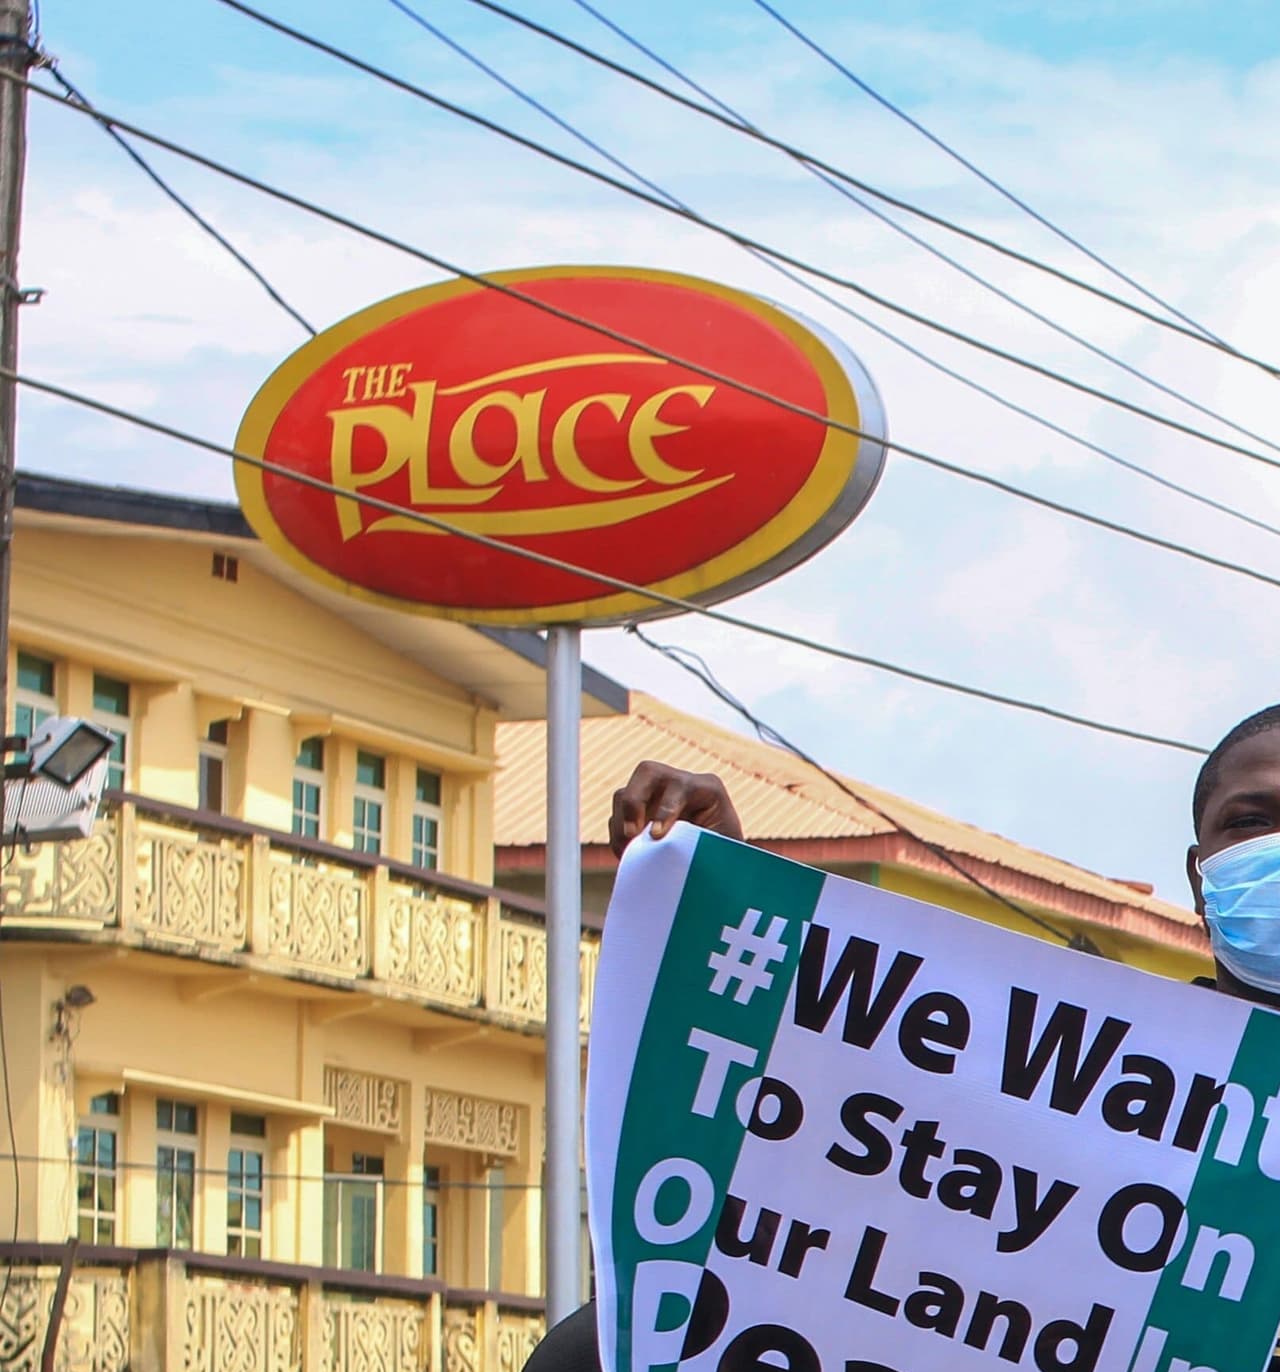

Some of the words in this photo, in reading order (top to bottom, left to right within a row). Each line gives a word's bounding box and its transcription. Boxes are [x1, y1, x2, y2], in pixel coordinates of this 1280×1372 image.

[342, 363, 413, 404] THE
[707, 907, 971, 1074] #We
[633, 1157, 831, 1281] Our
[685, 1028, 804, 1142] To
[826, 1092, 1079, 1253] Stay
[1096, 1182, 1256, 1302] On
